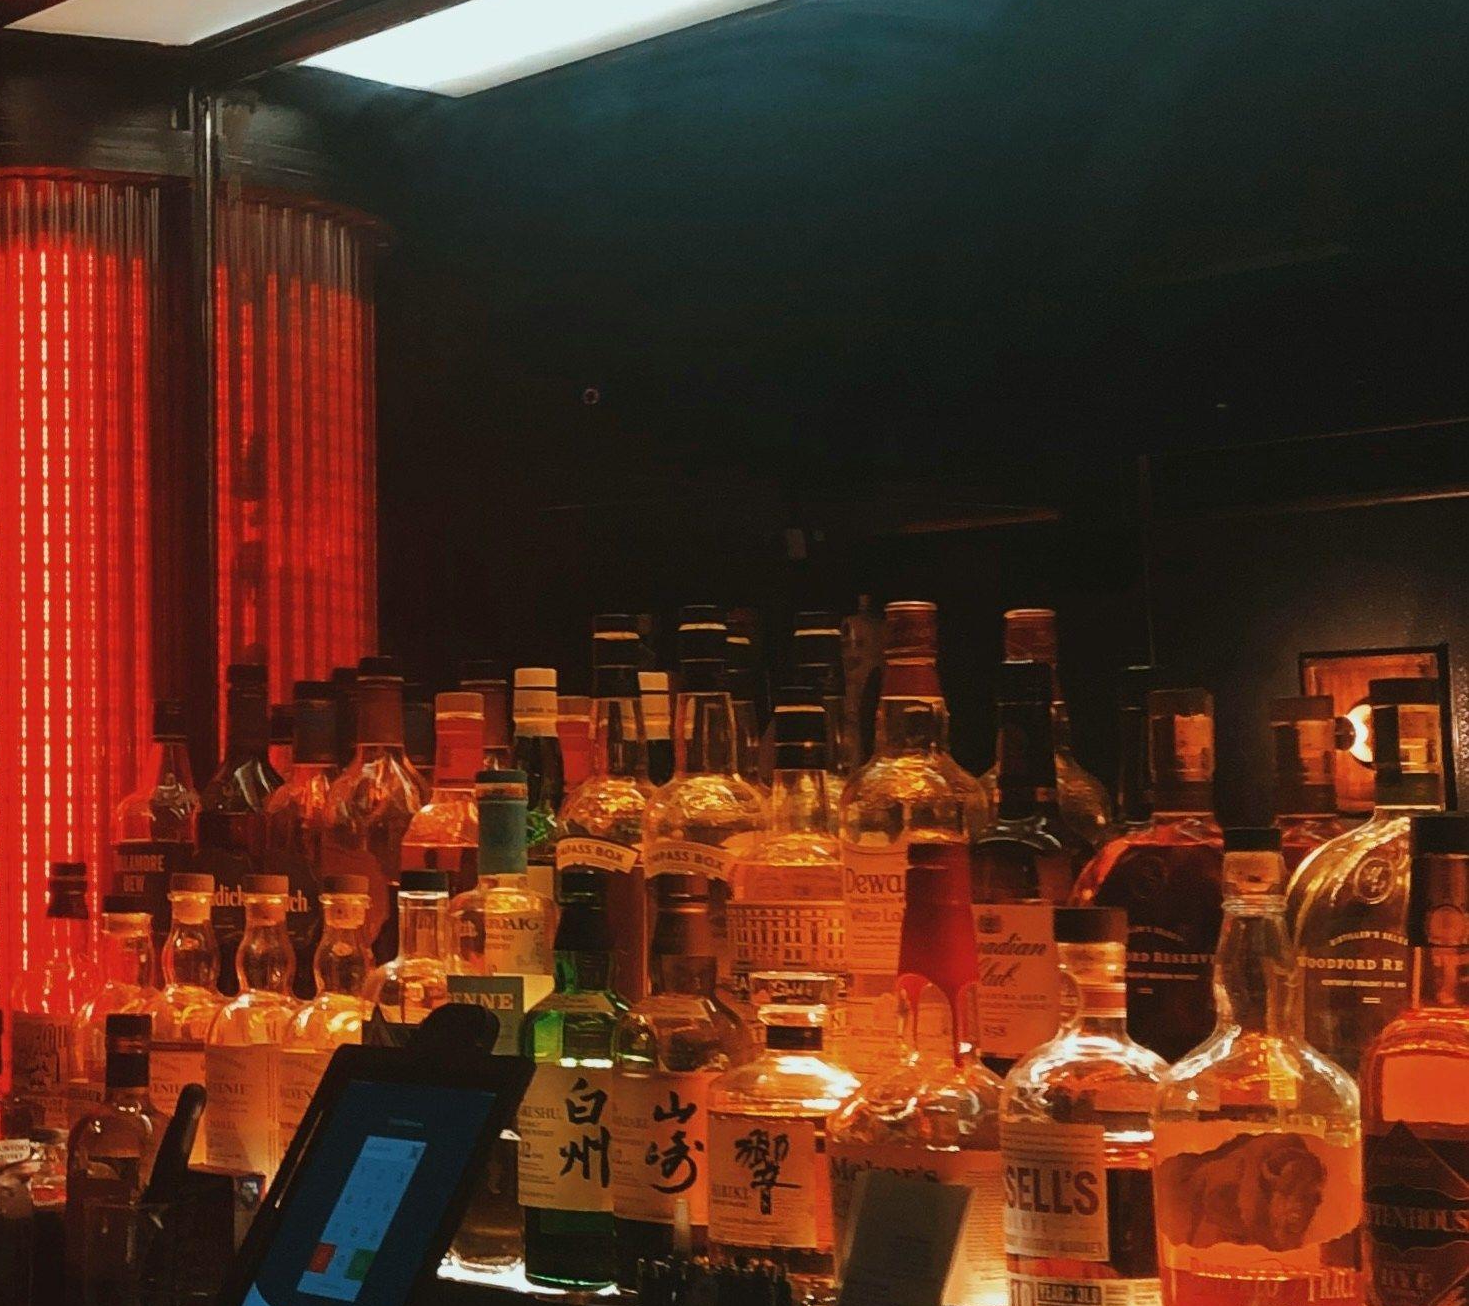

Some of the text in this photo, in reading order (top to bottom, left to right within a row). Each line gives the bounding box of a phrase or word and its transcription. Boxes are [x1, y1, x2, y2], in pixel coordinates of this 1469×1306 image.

[844, 867, 906, 895] Dewa
[1297, 956, 1377, 971] WOODFORD
[558, 1077, 612, 1189] 白州
